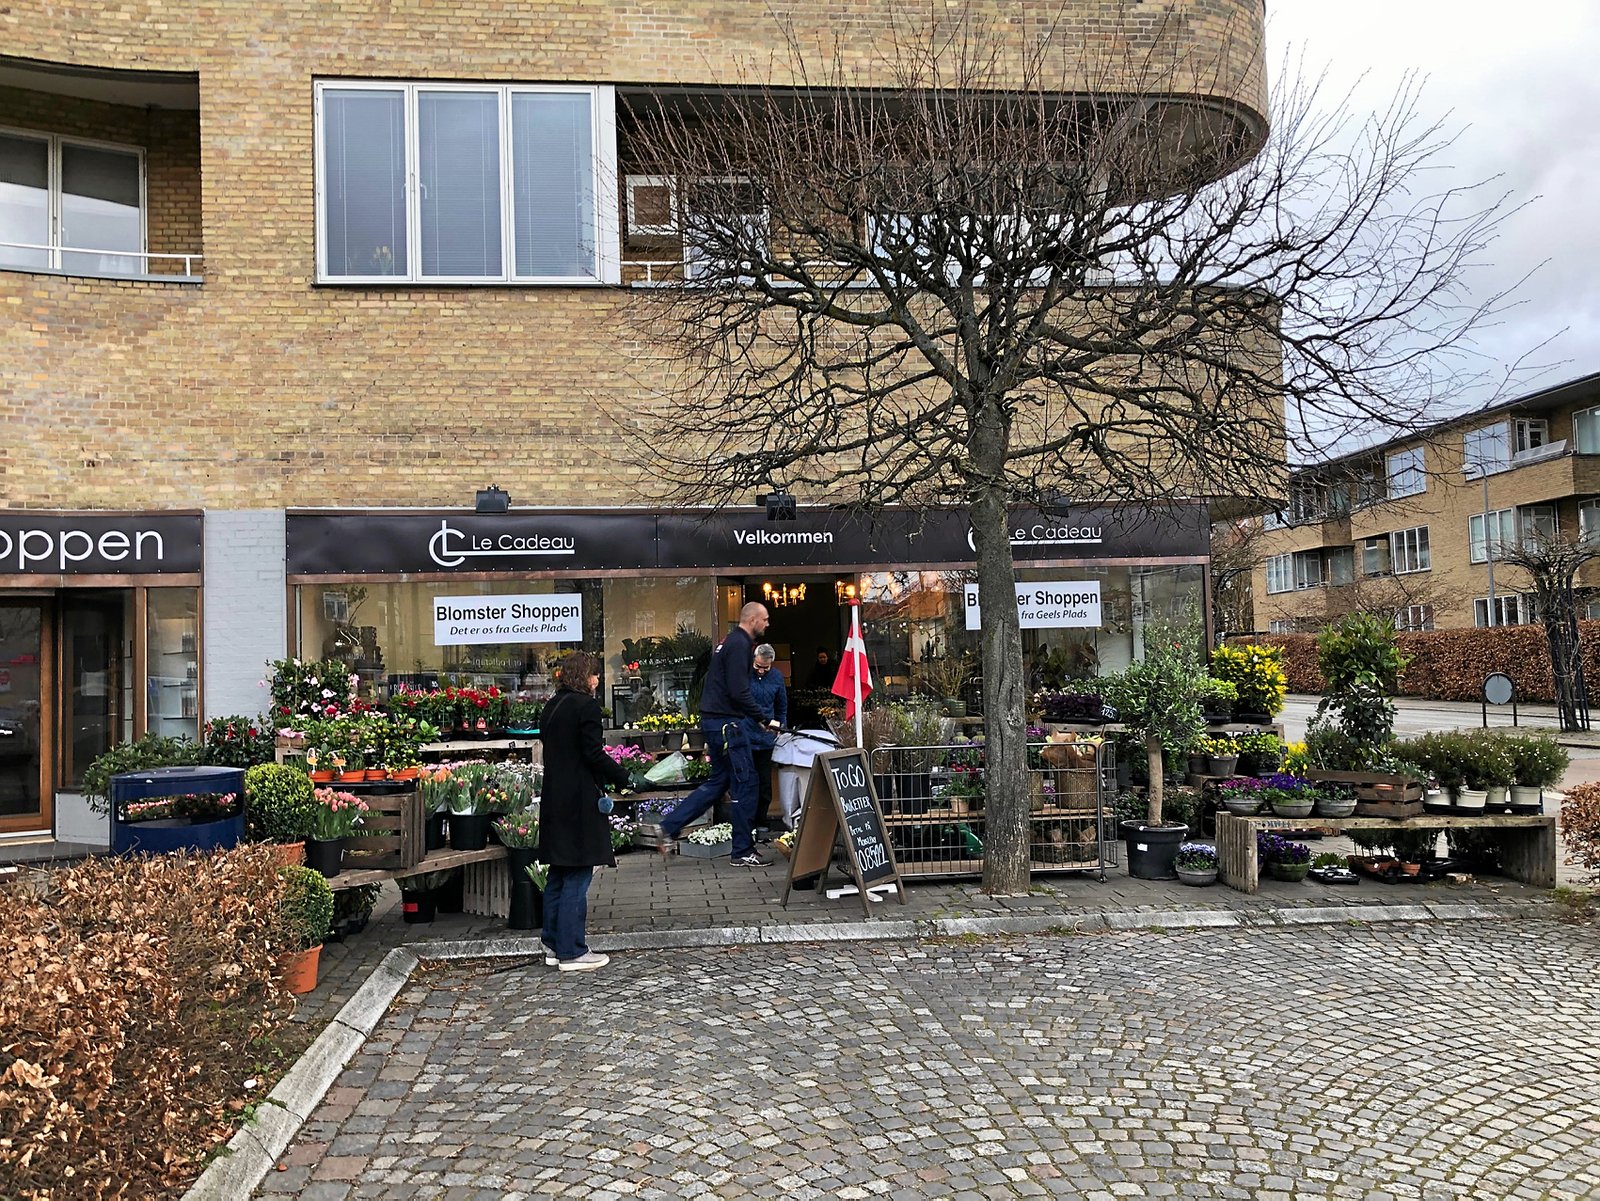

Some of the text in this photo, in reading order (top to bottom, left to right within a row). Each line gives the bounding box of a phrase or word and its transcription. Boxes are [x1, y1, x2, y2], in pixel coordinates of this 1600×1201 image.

[733, 529, 833, 544] Velkommen
[1031, 524, 1102, 540] Cadeau
[472, 534, 575, 550] Le Cadeau
[1035, 590, 1098, 608] Shoppen
[436, 603, 580, 621] Blomster Shoppen
[1021, 609, 1088, 619] fra Geels Plads
[450, 622, 567, 635] Det er os fra Geels Plads
